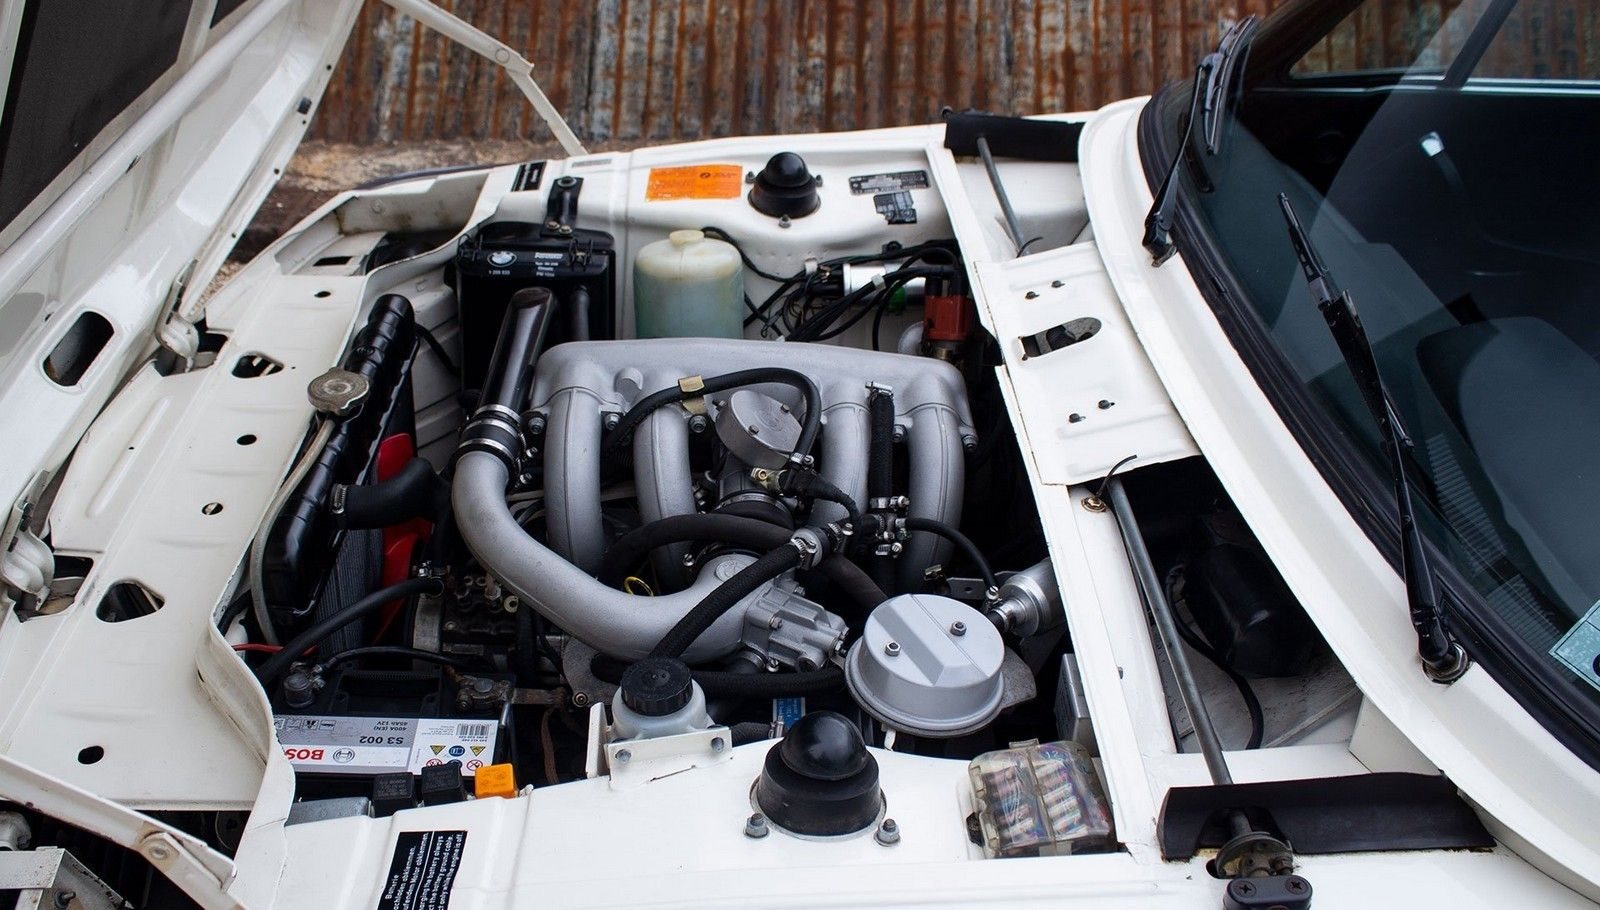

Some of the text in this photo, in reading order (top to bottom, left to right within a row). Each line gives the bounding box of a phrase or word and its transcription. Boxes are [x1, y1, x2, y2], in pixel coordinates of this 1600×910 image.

[360, 735, 403, 744] S3 002
[285, 749, 324, 760] BOS
[440, 852, 449, 872] ground
[451, 849, 460, 867] engine
[419, 836, 444, 910] arging the battery always
[446, 867, 454, 877] the
[403, 883, 415, 910] ufendem
[409, 866, 420, 883] Motor
[432, 873, 445, 892] battery
[442, 877, 451, 890] while
[393, 883, 406, 910] achladen
[428, 892, 437, 903] the
[439, 891, 448, 904] only
